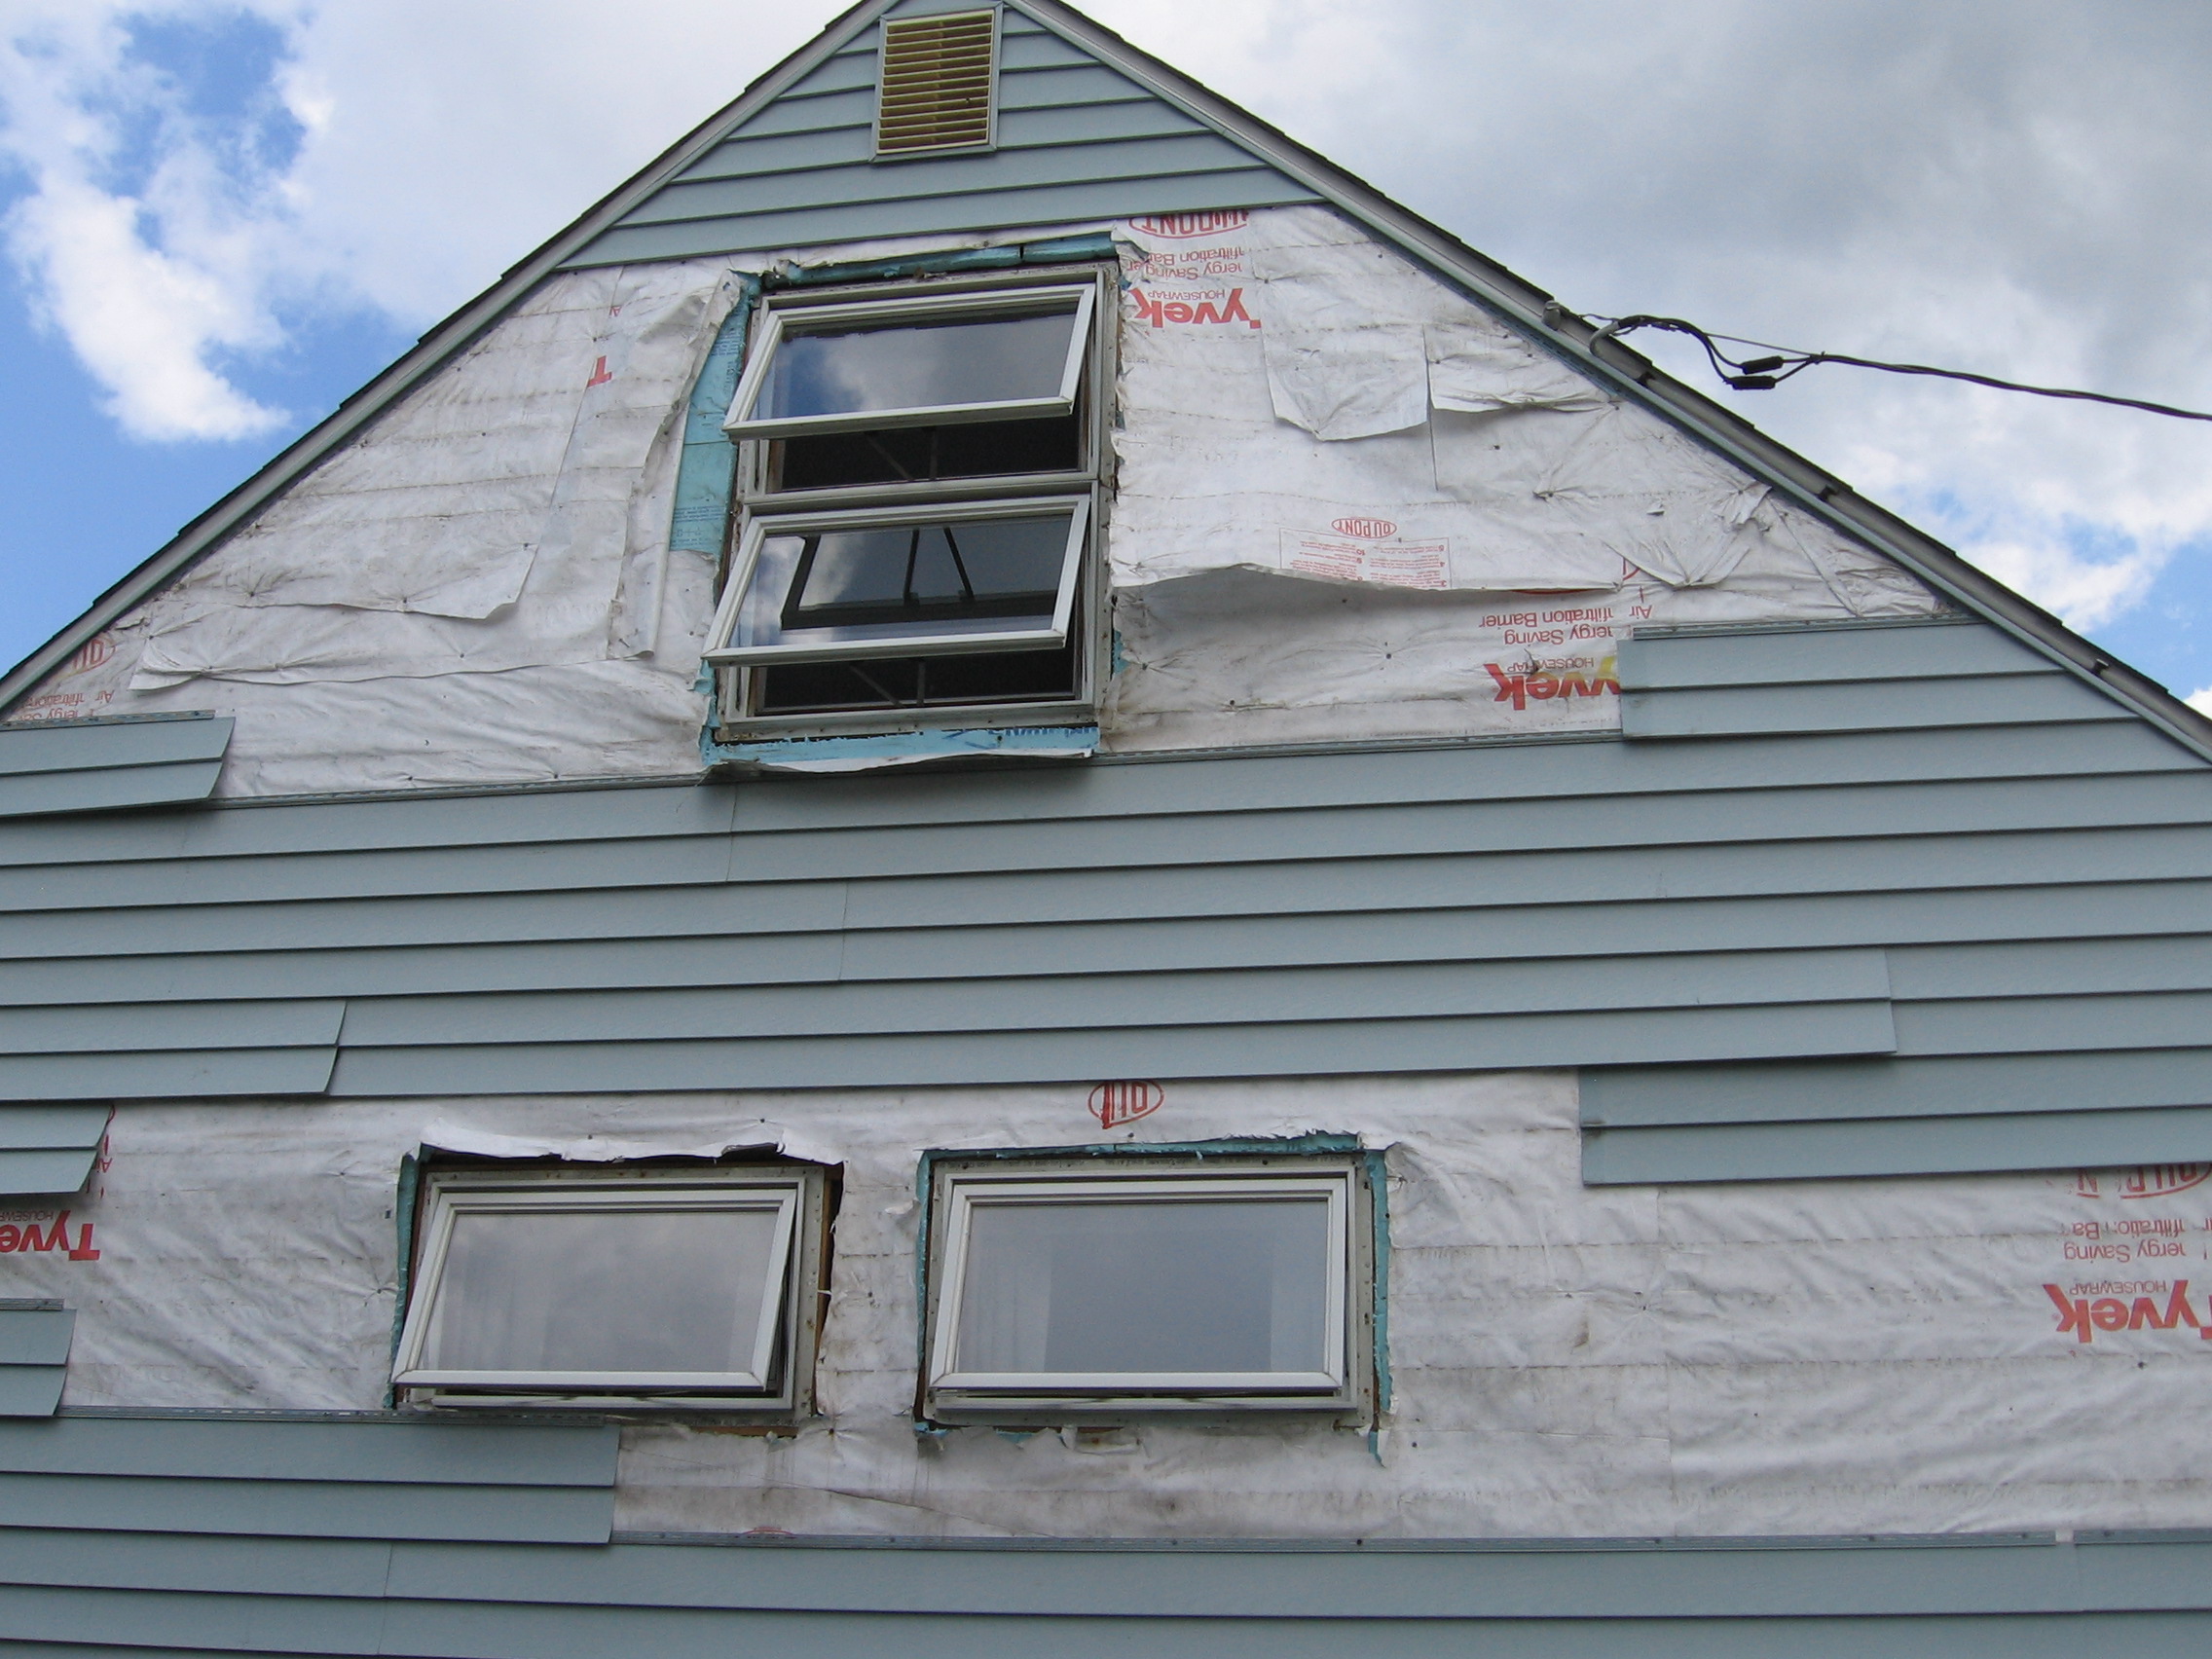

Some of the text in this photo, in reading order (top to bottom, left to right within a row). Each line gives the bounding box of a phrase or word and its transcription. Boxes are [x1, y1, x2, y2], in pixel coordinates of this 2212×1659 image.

[1146, 264, 1198, 280] Saving
[1147, 289, 1226, 301] HOUSEWRAP
[1127, 288, 1262, 329] yvek
[1629, 604, 1653, 620] Air
[1478, 611, 1537, 631] Barrier
[1503, 628, 1565, 646] Saving
[2063, 1241, 2131, 1263] Saving
[2069, 1280, 2167, 1296] HOUSEWRAP
